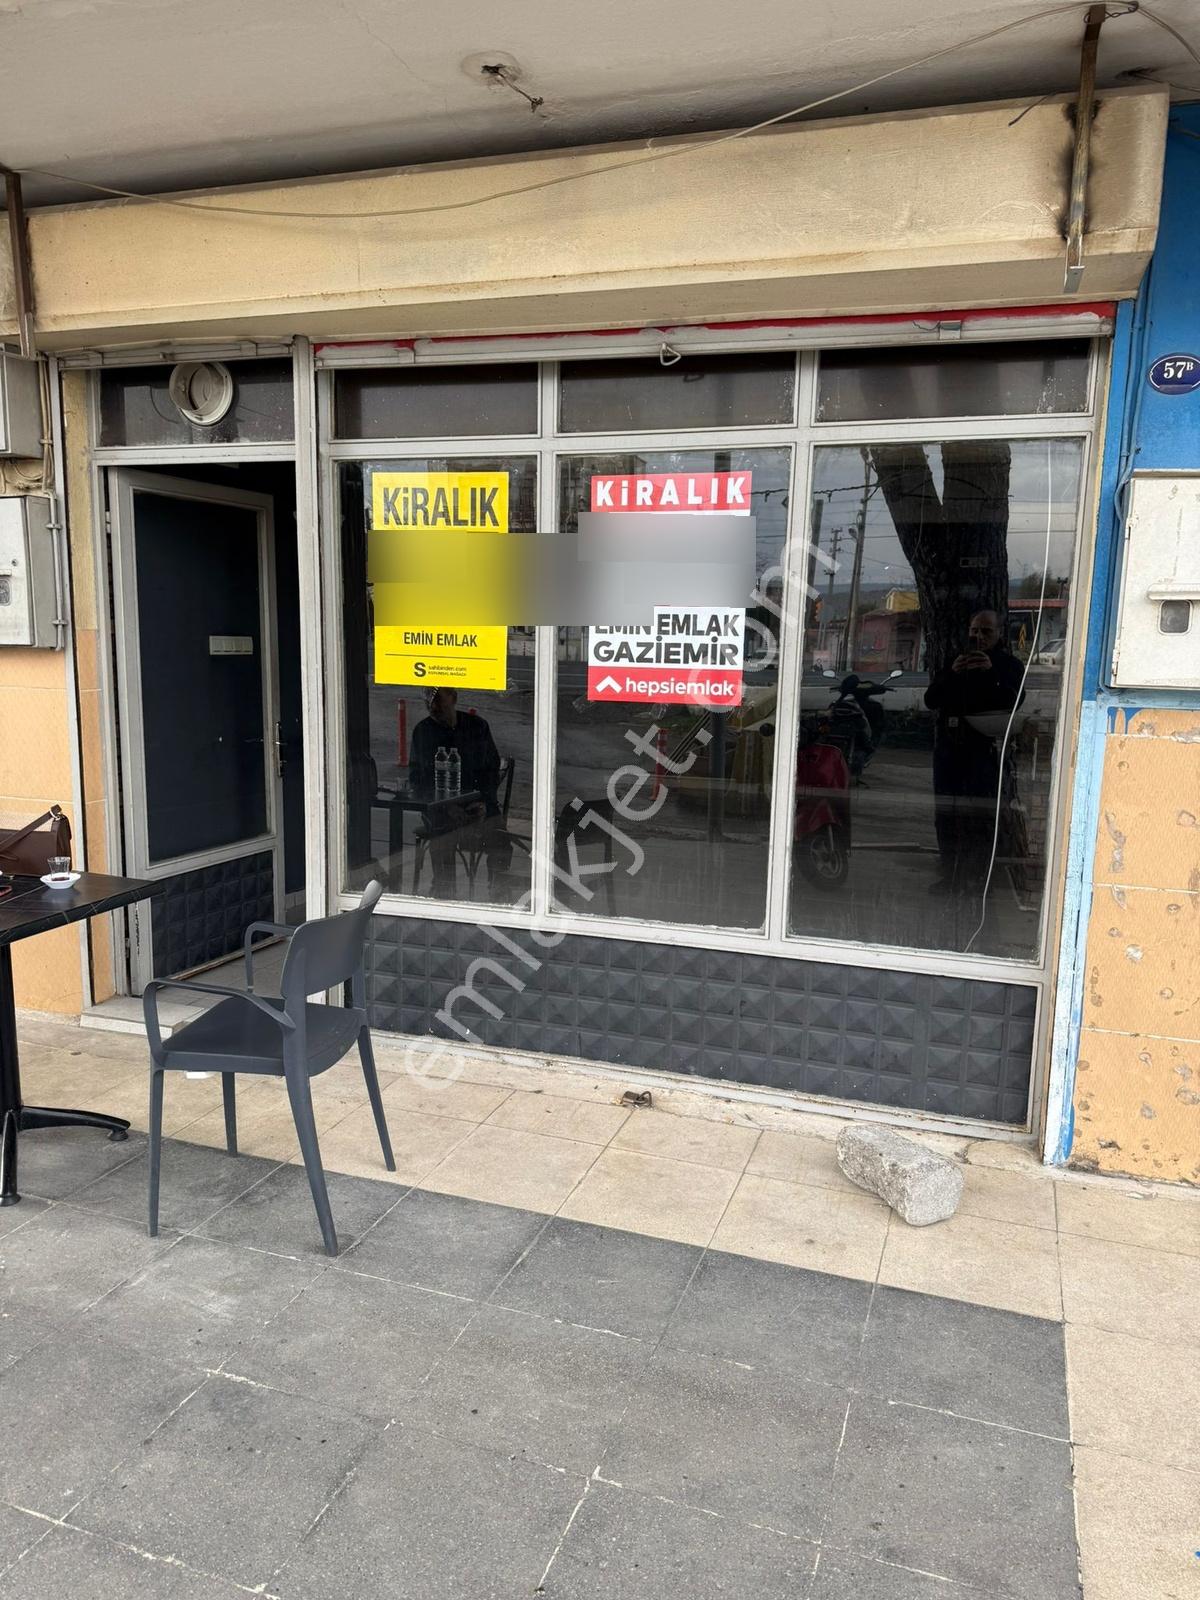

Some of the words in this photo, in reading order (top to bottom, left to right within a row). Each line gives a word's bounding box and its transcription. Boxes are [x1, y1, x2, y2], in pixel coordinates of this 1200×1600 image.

[1163, 361, 1194, 379] 57B
[656, 613, 740, 637] EMLAK
[403, 631, 433, 646] EMİN
[436, 633, 478, 648] EMLAK
[593, 635, 739, 666] GAZİEMİR
[625, 677, 735, 697] hepsiemlak
